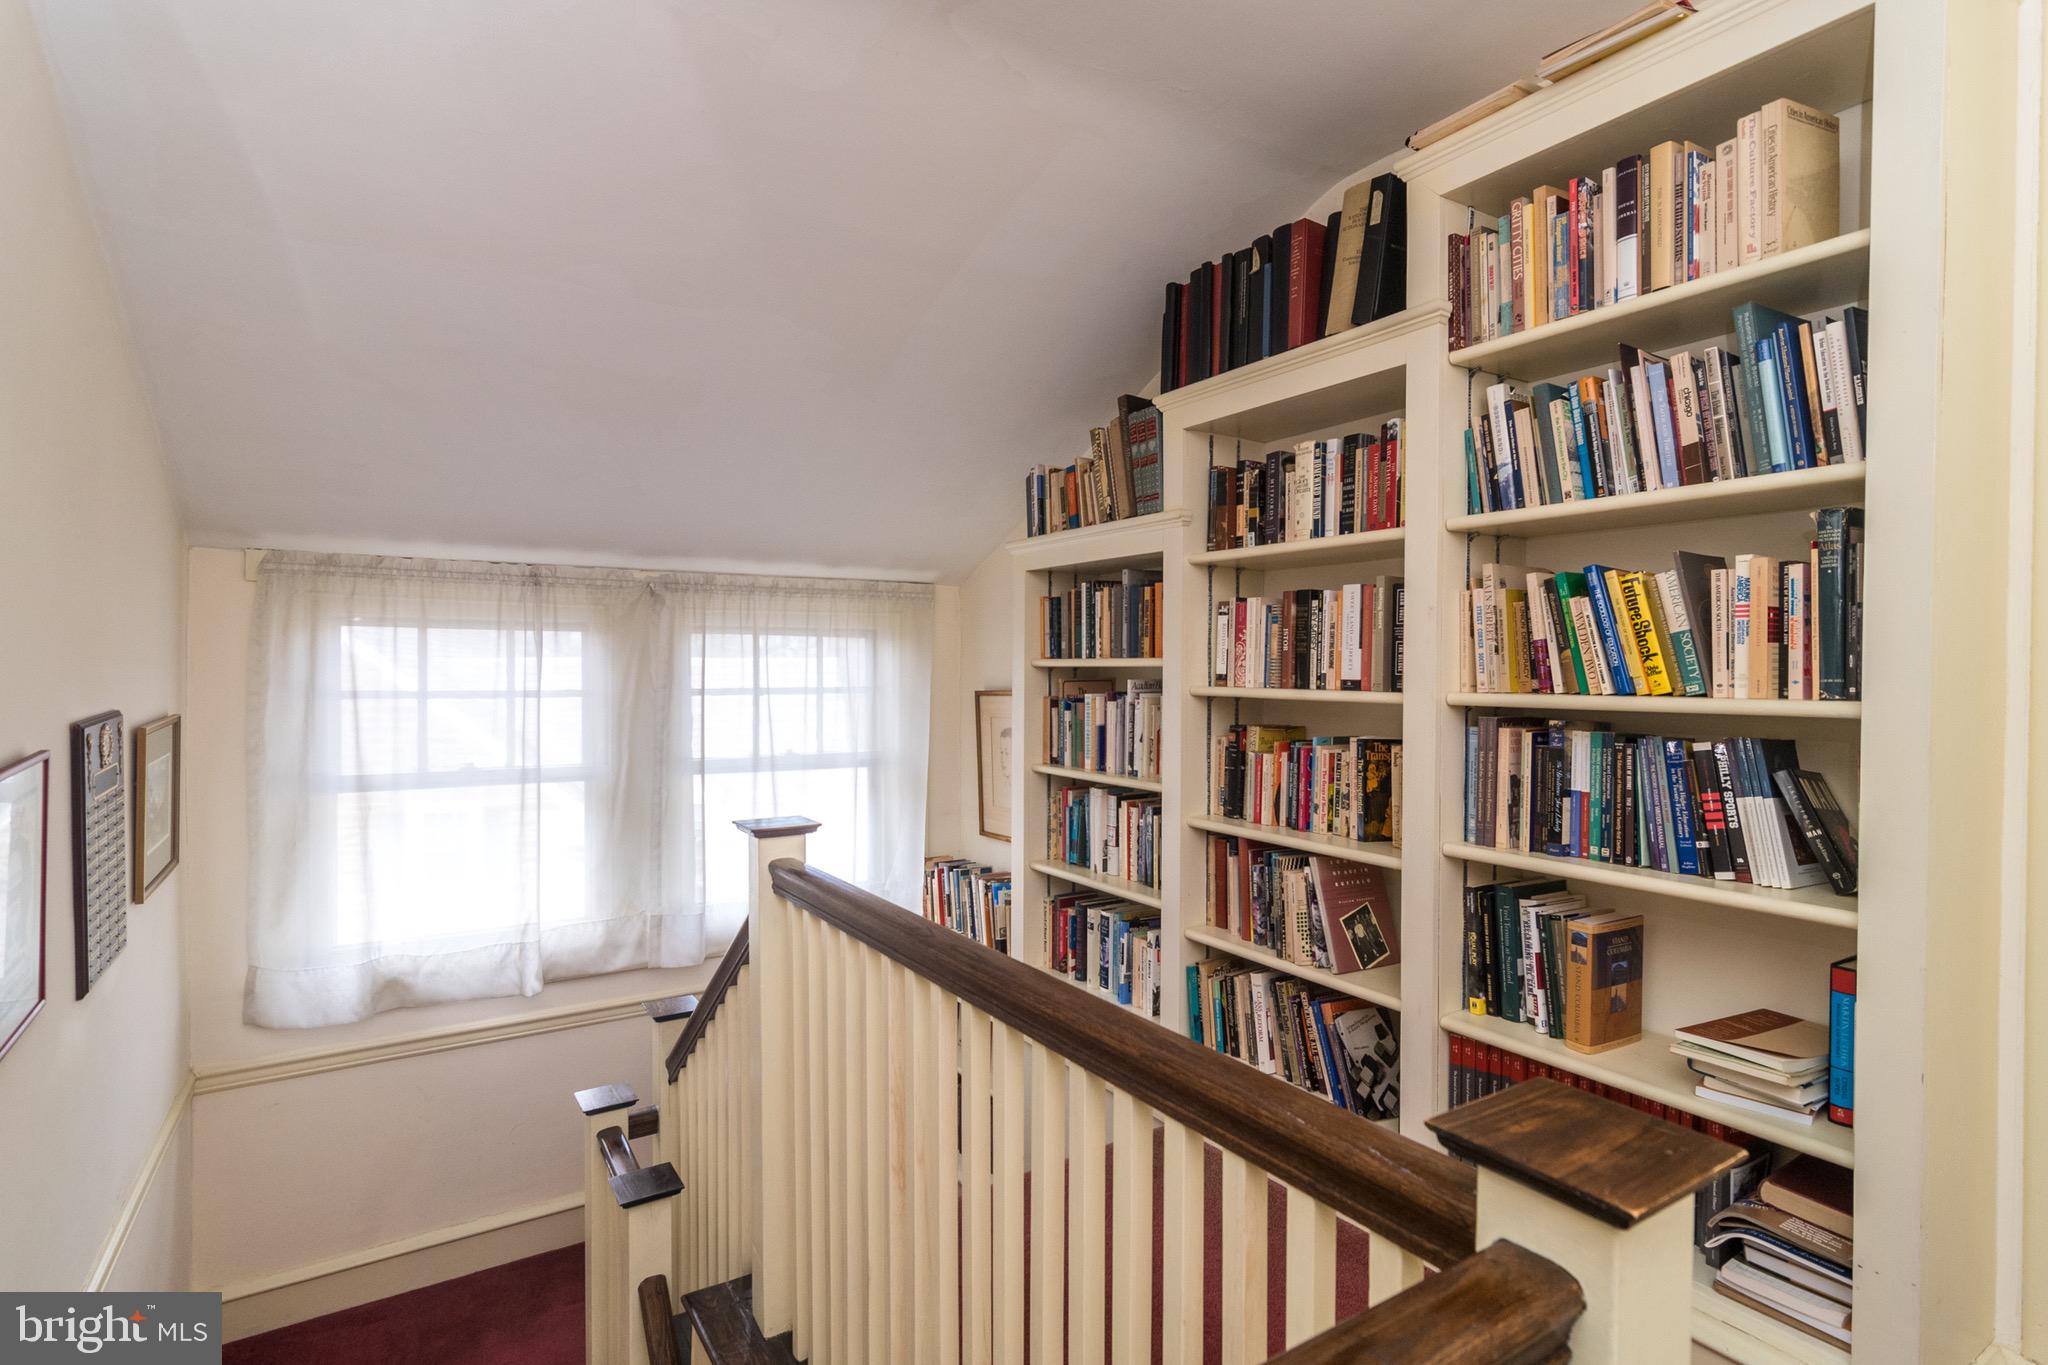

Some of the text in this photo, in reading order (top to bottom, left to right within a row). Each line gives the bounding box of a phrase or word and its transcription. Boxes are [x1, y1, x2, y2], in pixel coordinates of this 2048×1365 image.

[1768, 125, 1777, 145] Cities
[1748, 116, 1757, 239] The Culture Factory
[1767, 154, 1777, 189] American
[1767, 190, 1777, 217] History
[1512, 202, 1523, 280] GRITTY CITIES
[1570, 385, 1578, 396] The
[1574, 423, 1584, 445] System
[1682, 388, 1694, 417] chicago
[1484, 574, 1494, 643] MAIN STREET
[1621, 578, 1640, 621] Future
[1665, 571, 1688, 630] AMERICAN
[1521, 631, 1529, 679] DEMOCRACY
[1574, 612, 1596, 680] WALDEN TWO
[1632, 622, 1658, 663] Shock
[1681, 633, 1699, 678] SOCIETY
[1374, 742, 1388, 752] The
[1677, 768, 1690, 838] American Higher Education
[1716, 756, 1739, 828] PHILLY SPORTS
[1676, 817, 1684, 838] Century
[1806, 830, 1822, 838] MAN
[1505, 956, 1513, 984] Stanford
[1526, 978, 1534, 997] GAME
[1227, 995, 1235, 1026] Geography
[1278, 984, 1291, 1034] Before the Ghetto
[1309, 1042, 1318, 1054] ALL
